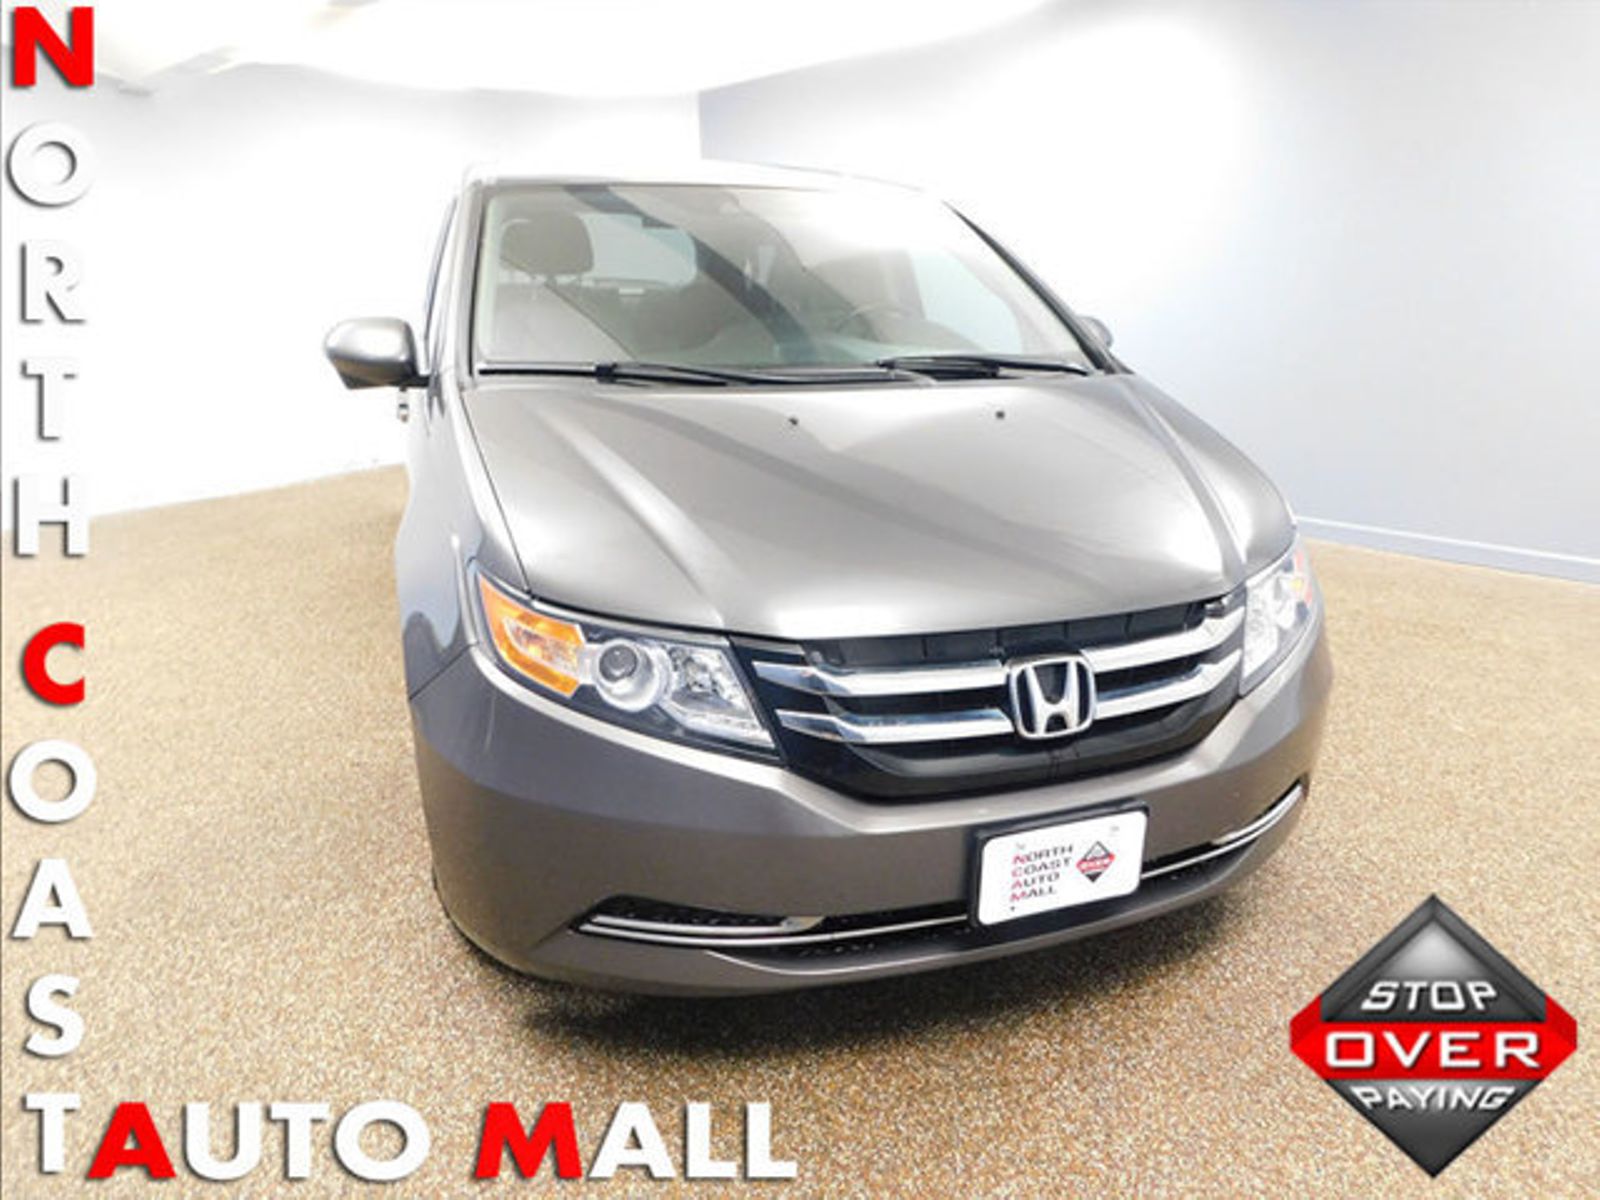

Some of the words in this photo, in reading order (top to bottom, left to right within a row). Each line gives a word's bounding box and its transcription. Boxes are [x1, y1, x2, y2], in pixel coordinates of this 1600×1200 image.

[1012, 845, 1073, 865] NORTH
[1012, 856, 1071, 878] COAST
[1011, 872, 1060, 890] AUTO
[1009, 886, 1058, 902] MALL
